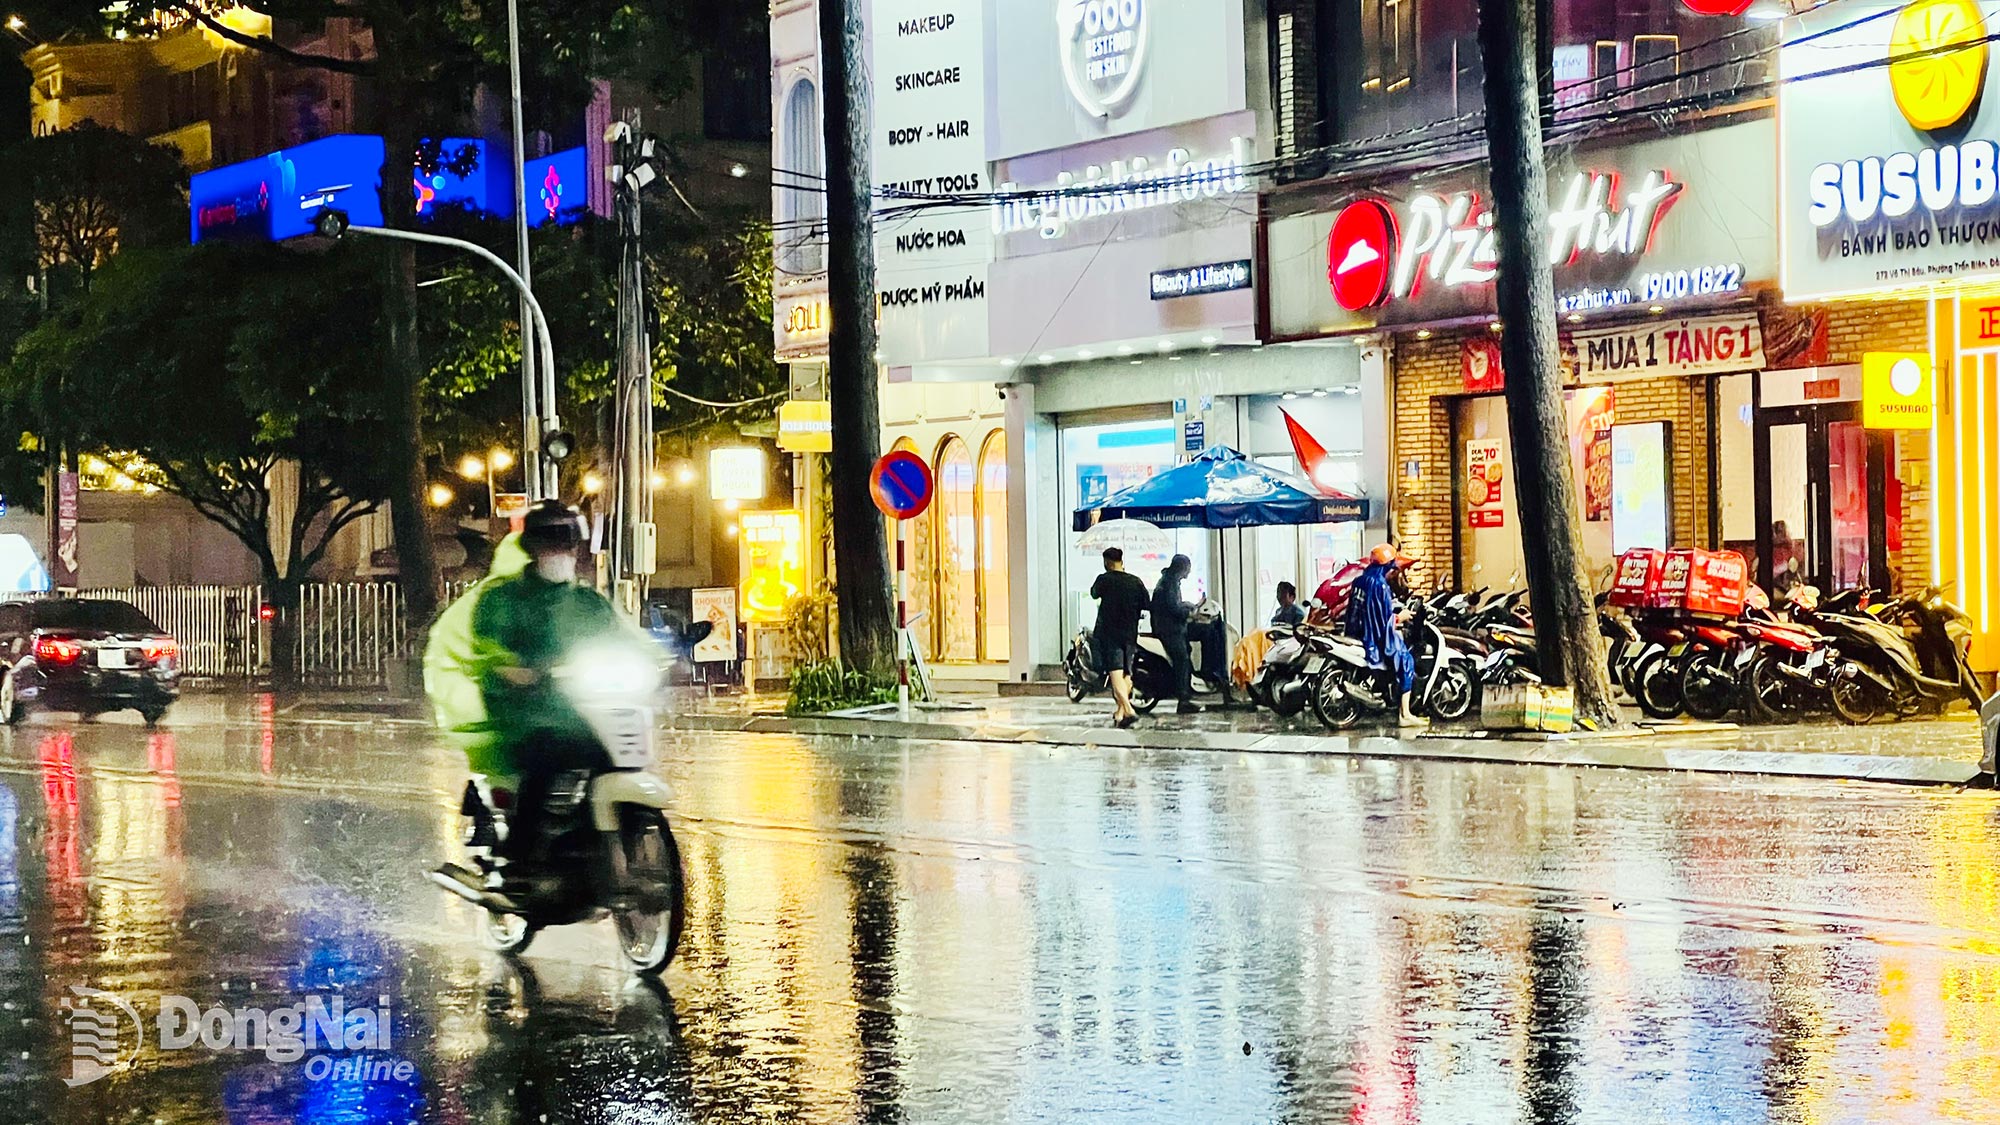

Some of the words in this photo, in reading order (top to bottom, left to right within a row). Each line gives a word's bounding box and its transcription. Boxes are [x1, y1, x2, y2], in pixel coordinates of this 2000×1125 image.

[898, 13, 955, 37] MAKEUP
[1085, 35, 1108, 59] BEST
[1108, 31, 1132, 53] FOOD
[895, 67, 960, 91] SKINCARE
[1086, 60, 1103, 80] FOR
[1103, 55, 1126, 77] SKIN
[889, 126, 922, 146] BODY
[936, 120, 969, 140] HAIR
[882, 179, 932, 200] BEAUTY
[936, 173, 979, 193] TOOLS
[1808, 139, 2000, 228] SUSUB
[1549, 170, 1683, 264] Hut
[896, 228, 934, 254] NƯỚC
[937, 229, 966, 248] HOA
[1841, 231, 1887, 258] BÁNH
[1894, 228, 1931, 251] BAO
[881, 287, 918, 308] DƯỢC
[945, 275, 985, 301] PHẨM
[1152, 271, 1189, 294] Beauty
[1190, 271, 1199, 288] &
[1199, 263, 1245, 290] Lifestyle
[1640, 269, 1688, 302] 1900
[1691, 263, 1742, 295] 1822
[783, 299, 822, 333] JOLI
[1587, 335, 1641, 372] MUA
[1645, 332, 1658, 367] 1
[1664, 320, 1735, 370] TẶNG
[1740, 324, 1753, 359] 1
[1880, 404, 1928, 414] SUSUBAO
